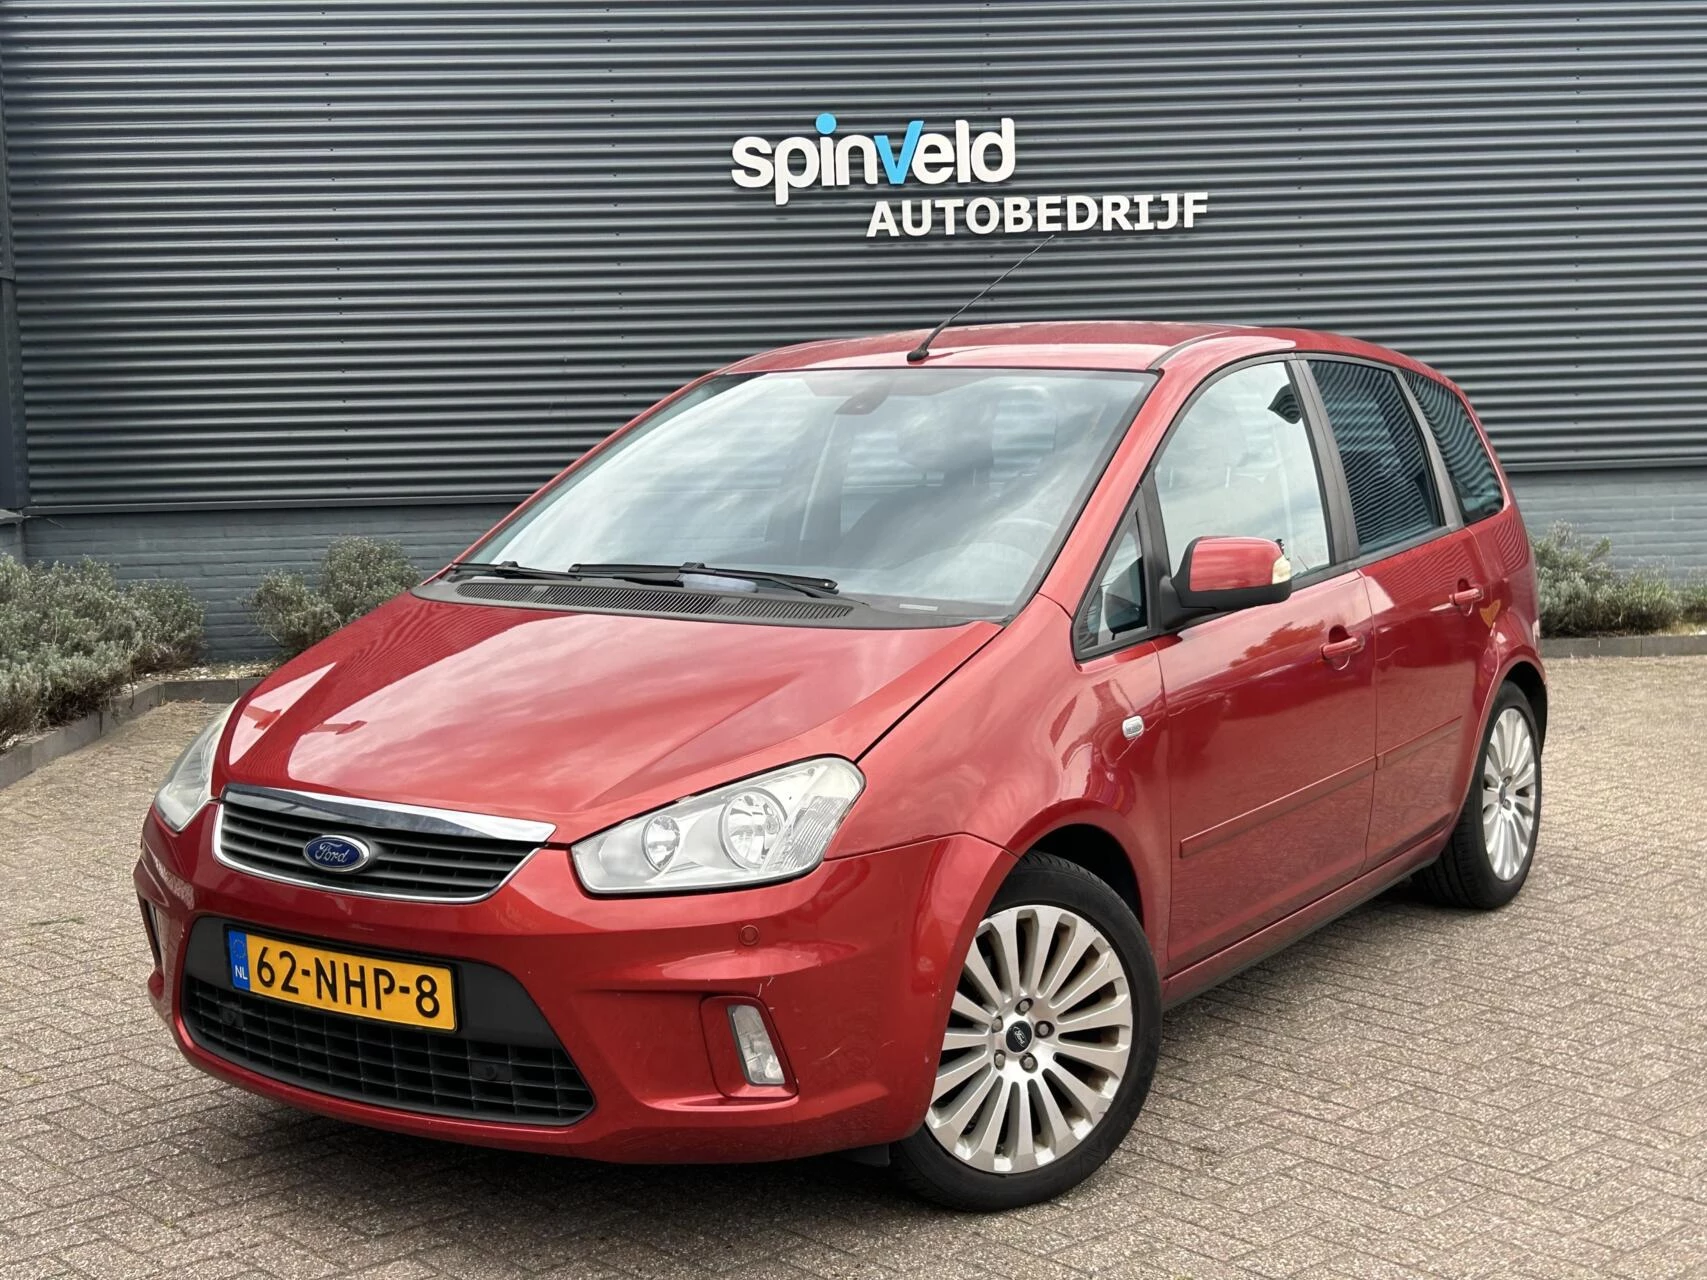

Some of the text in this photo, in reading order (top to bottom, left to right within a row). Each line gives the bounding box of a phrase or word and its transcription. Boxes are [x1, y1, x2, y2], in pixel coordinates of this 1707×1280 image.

[731, 113, 1016, 206] spinveld
[866, 191, 1209, 238] AUTOBEDRIJF
[314, 841, 350, 863] Ford
[234, 964, 249, 981] NL
[256, 946, 441, 1019] 62-NHP-8
